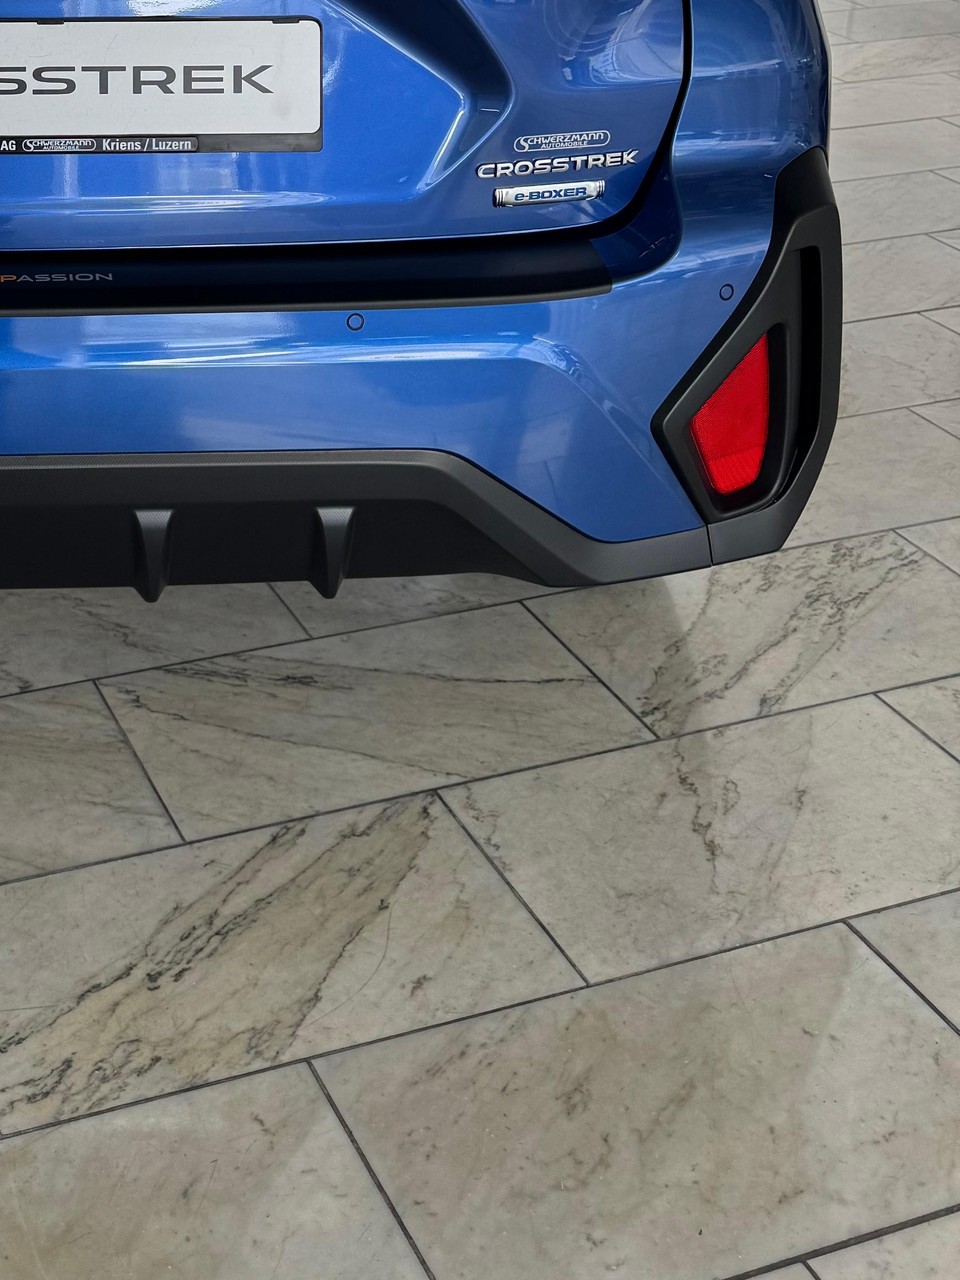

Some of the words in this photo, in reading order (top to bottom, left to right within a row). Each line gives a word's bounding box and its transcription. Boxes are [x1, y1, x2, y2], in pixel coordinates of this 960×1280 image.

[1, 140, 16, 151] AG
[25, 139, 92, 151] SCHWERZMANN
[102, 138, 141, 151] Kriens
[152, 138, 192, 151] Luzern
[520, 132, 604, 152] SCHWERZMANN
[541, 141, 589, 149] AUTOMOBILE
[477, 149, 639, 178] CROSSTREK
[514, 187, 588, 202] e-BOXER
[0, 273, 113, 283] PASSION
